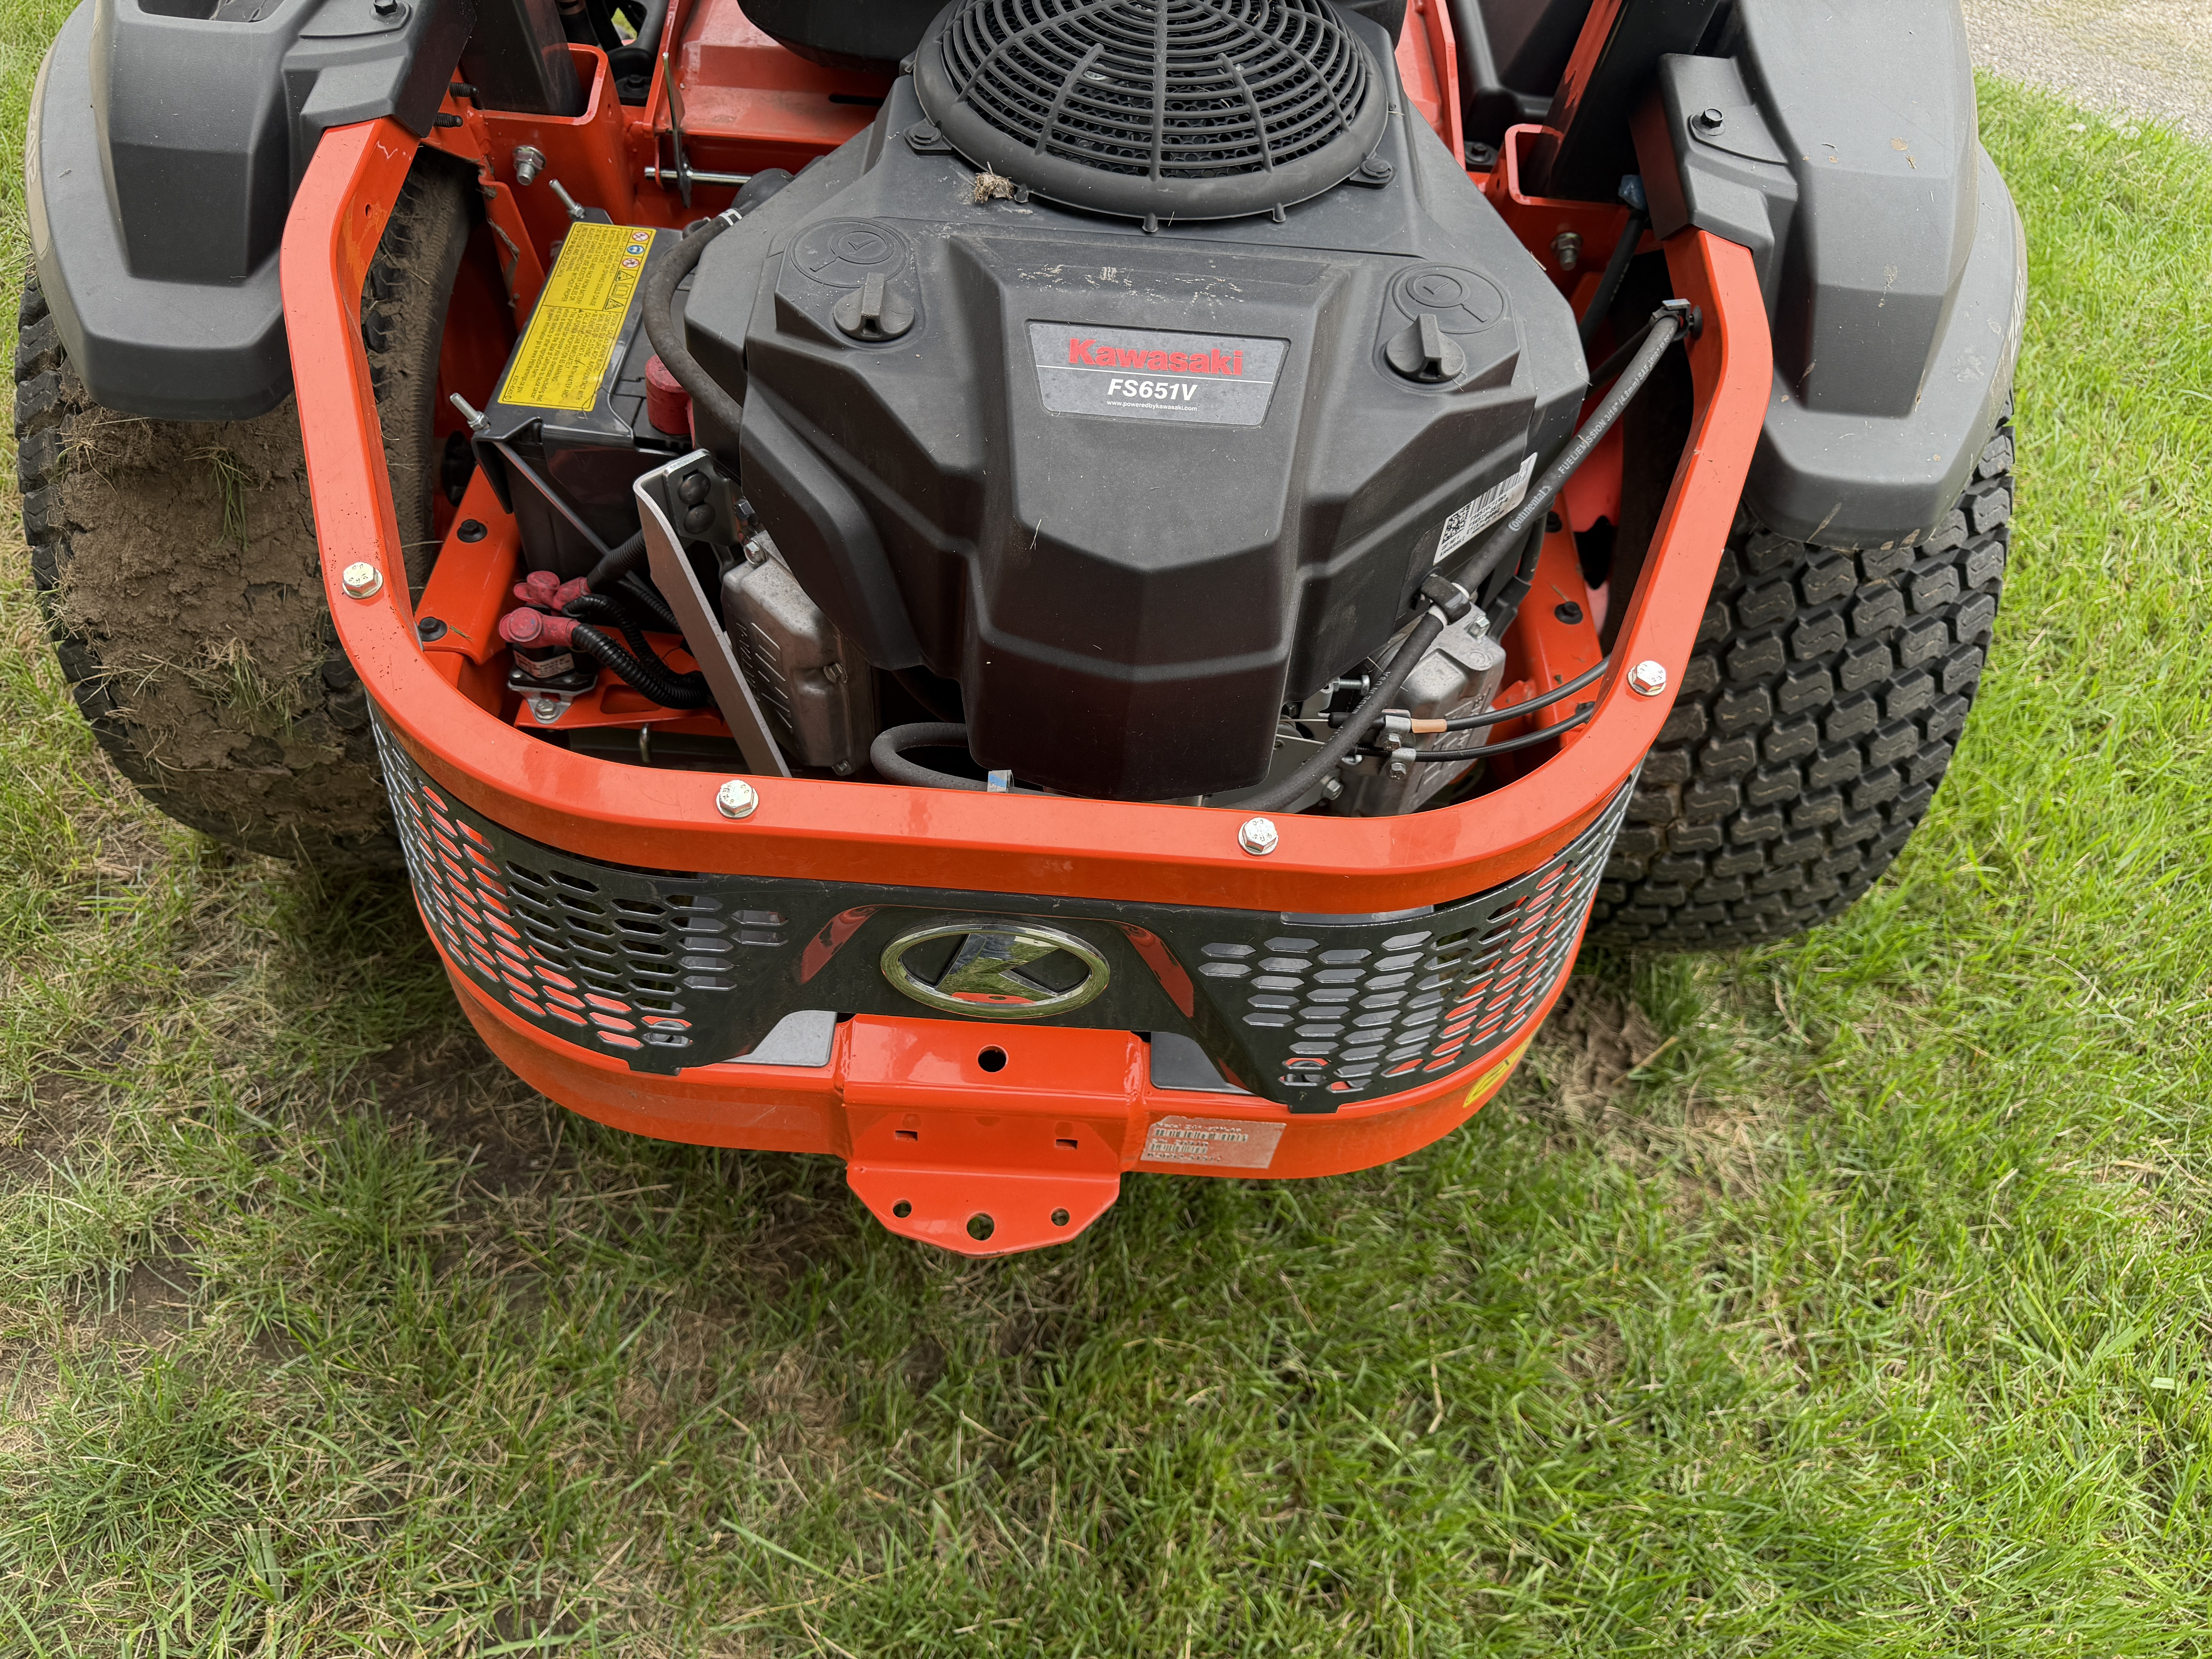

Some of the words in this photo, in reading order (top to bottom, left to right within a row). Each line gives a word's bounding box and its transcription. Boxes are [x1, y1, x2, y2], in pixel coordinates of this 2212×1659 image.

[1068, 338, 1243, 376] Kawasaki
[1107, 379, 1198, 401] FS651V
[1618, 378, 1640, 406] (4.8mm)
[1637, 364, 1650, 380] SAE
[1106, 400, 1198, 412] www.poweredbykawasaki.com
[1508, 489, 1546, 531] Continental
[1375, 672, 1391, 685] USA
